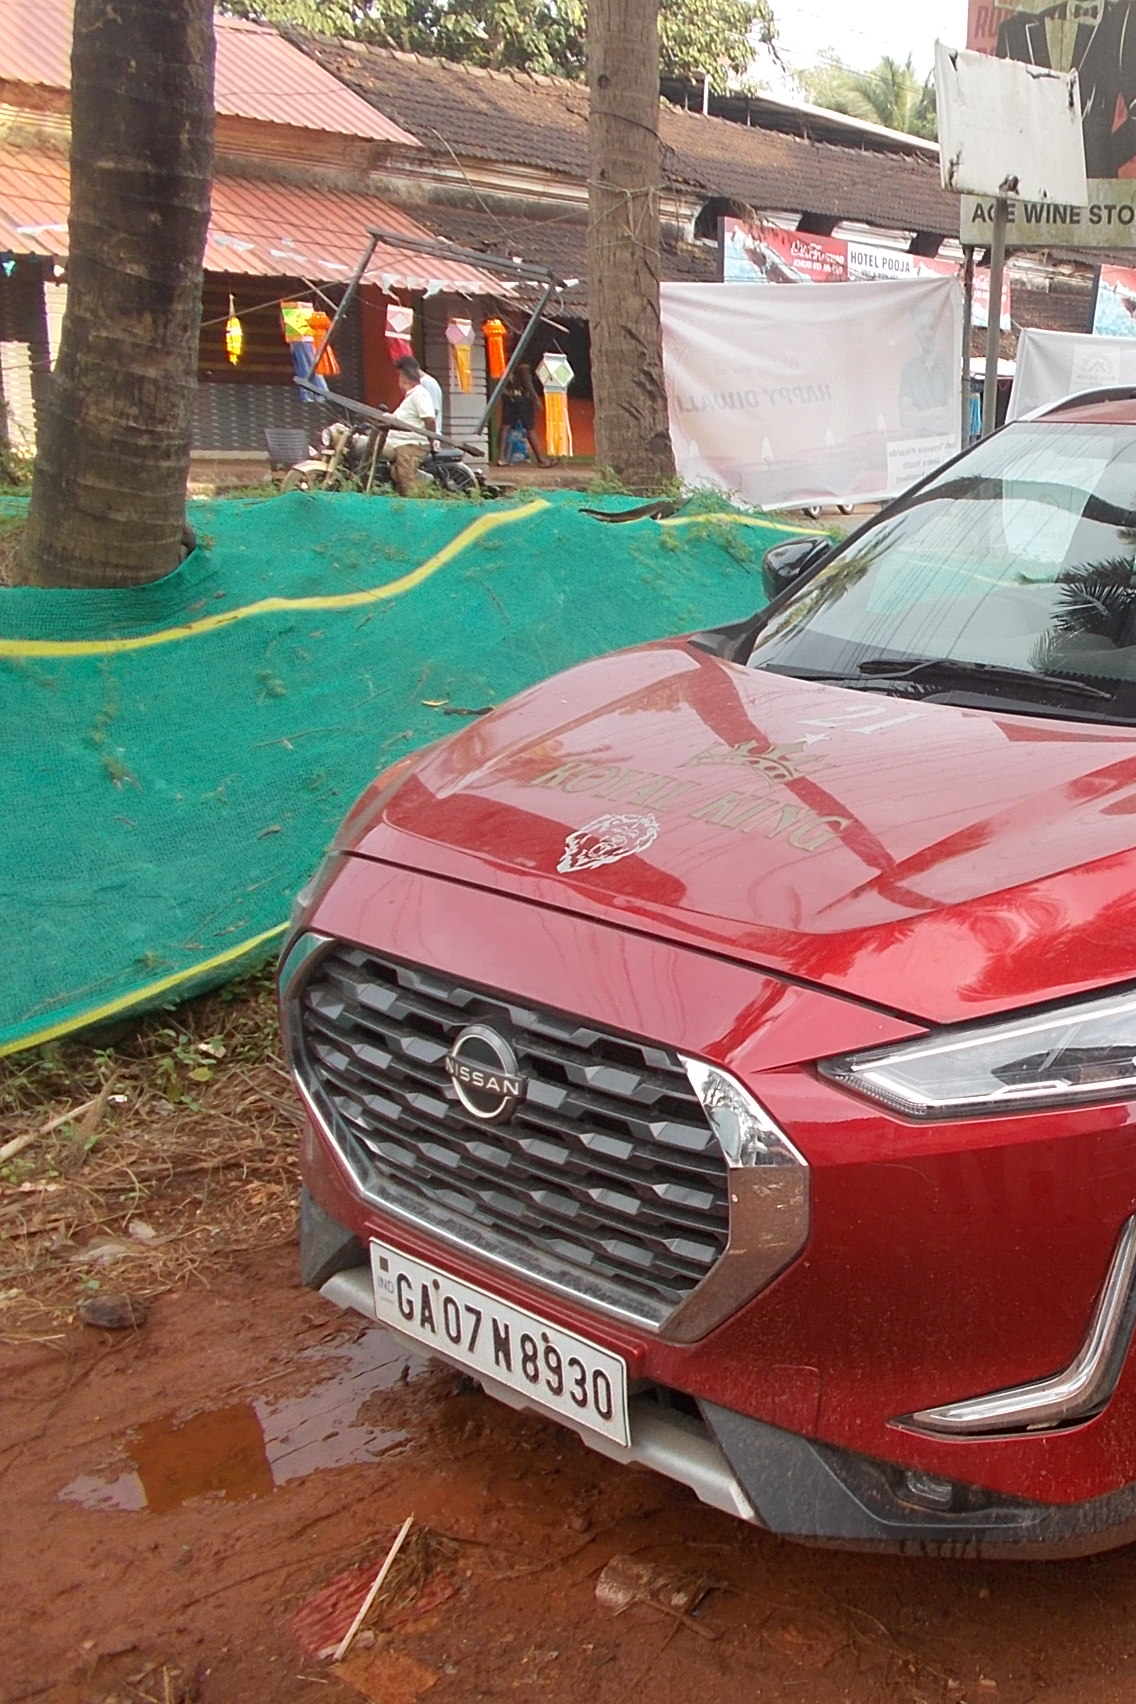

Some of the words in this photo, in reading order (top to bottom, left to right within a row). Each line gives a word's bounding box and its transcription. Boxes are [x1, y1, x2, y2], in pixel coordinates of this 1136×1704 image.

[1024, 205, 1081, 225] WINE
[850, 250, 880, 269] HOTEL
[882, 256, 911, 273] POOJA
[530, 760, 702, 813] ROYAL
[688, 790, 854, 852] KING
[446, 1057, 519, 1095] NISSAN
[377, 1275, 395, 1294] IND
